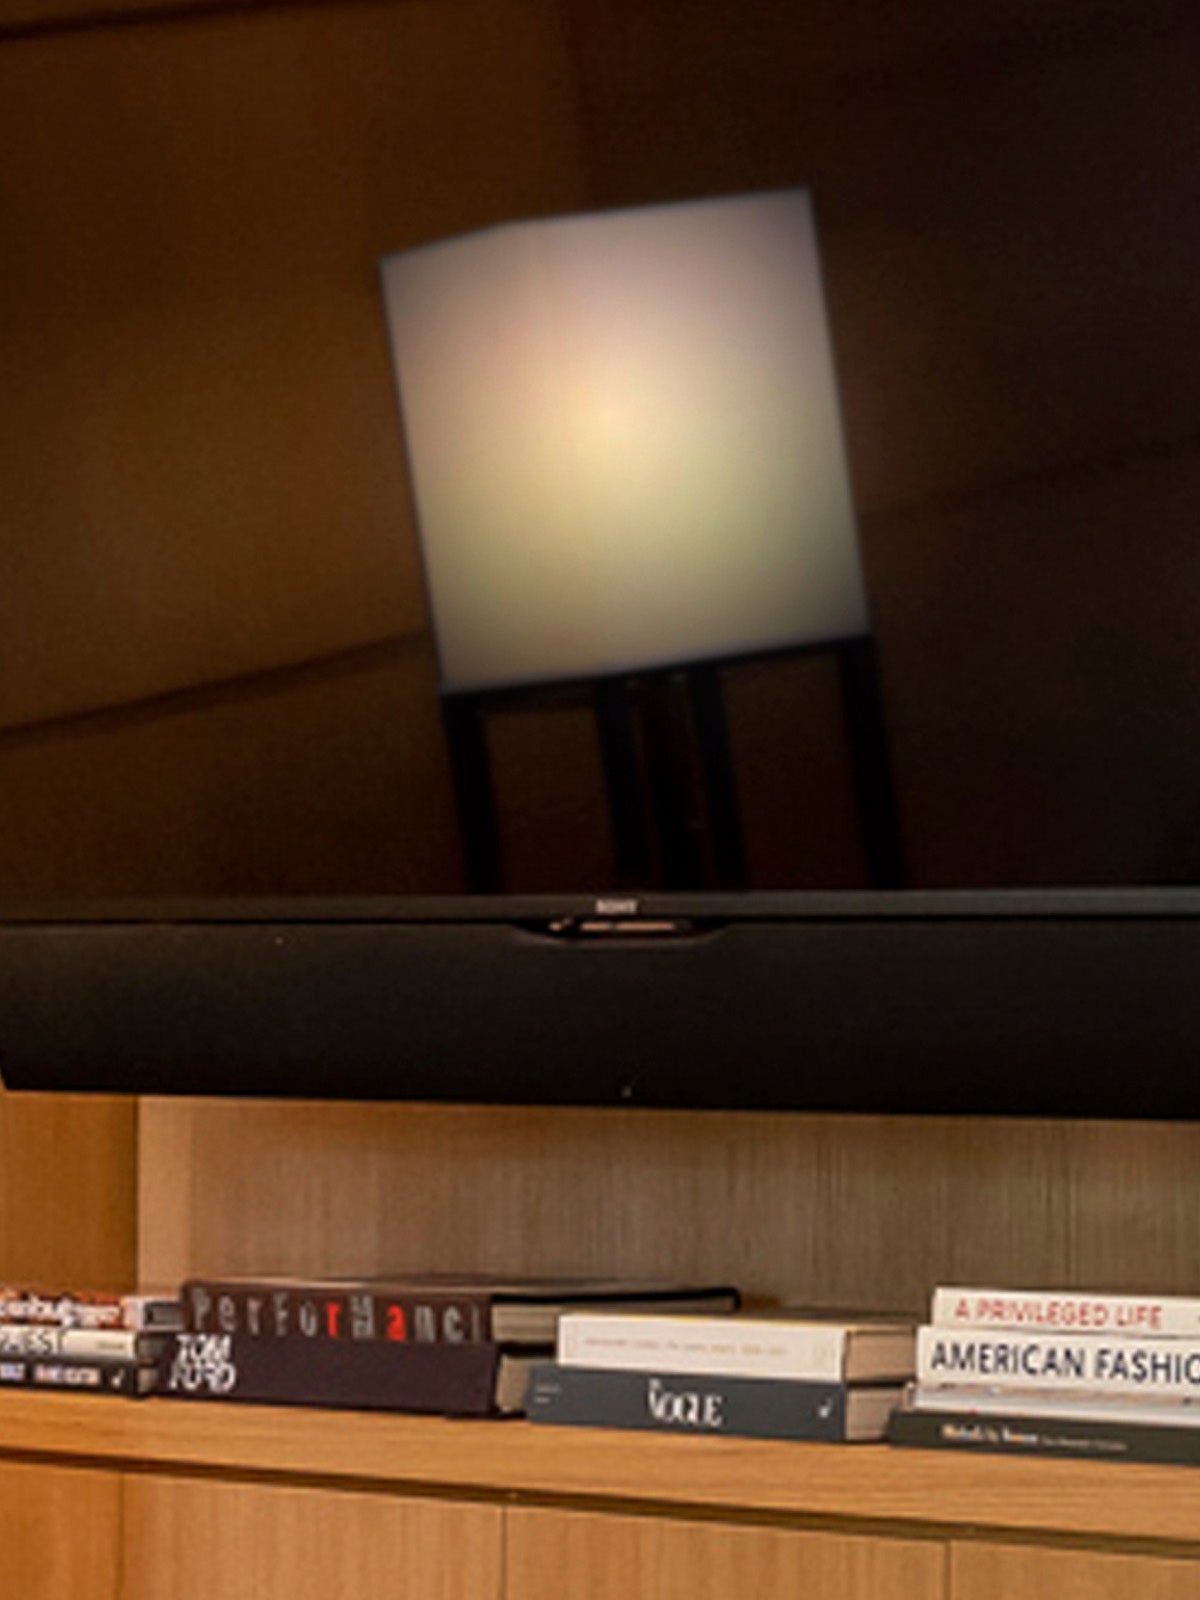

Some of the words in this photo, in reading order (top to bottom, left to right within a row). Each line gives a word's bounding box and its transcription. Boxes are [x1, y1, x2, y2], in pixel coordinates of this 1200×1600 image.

[953, 1297, 970, 1320] A
[975, 1299, 1109, 1326] PRIVILEGED
[1116, 1306, 1163, 1329] LIFE
[176, 1333, 232, 1361] TOM
[931, 1342, 1085, 1378] AMERICAN
[169, 1360, 237, 1393] FORD
